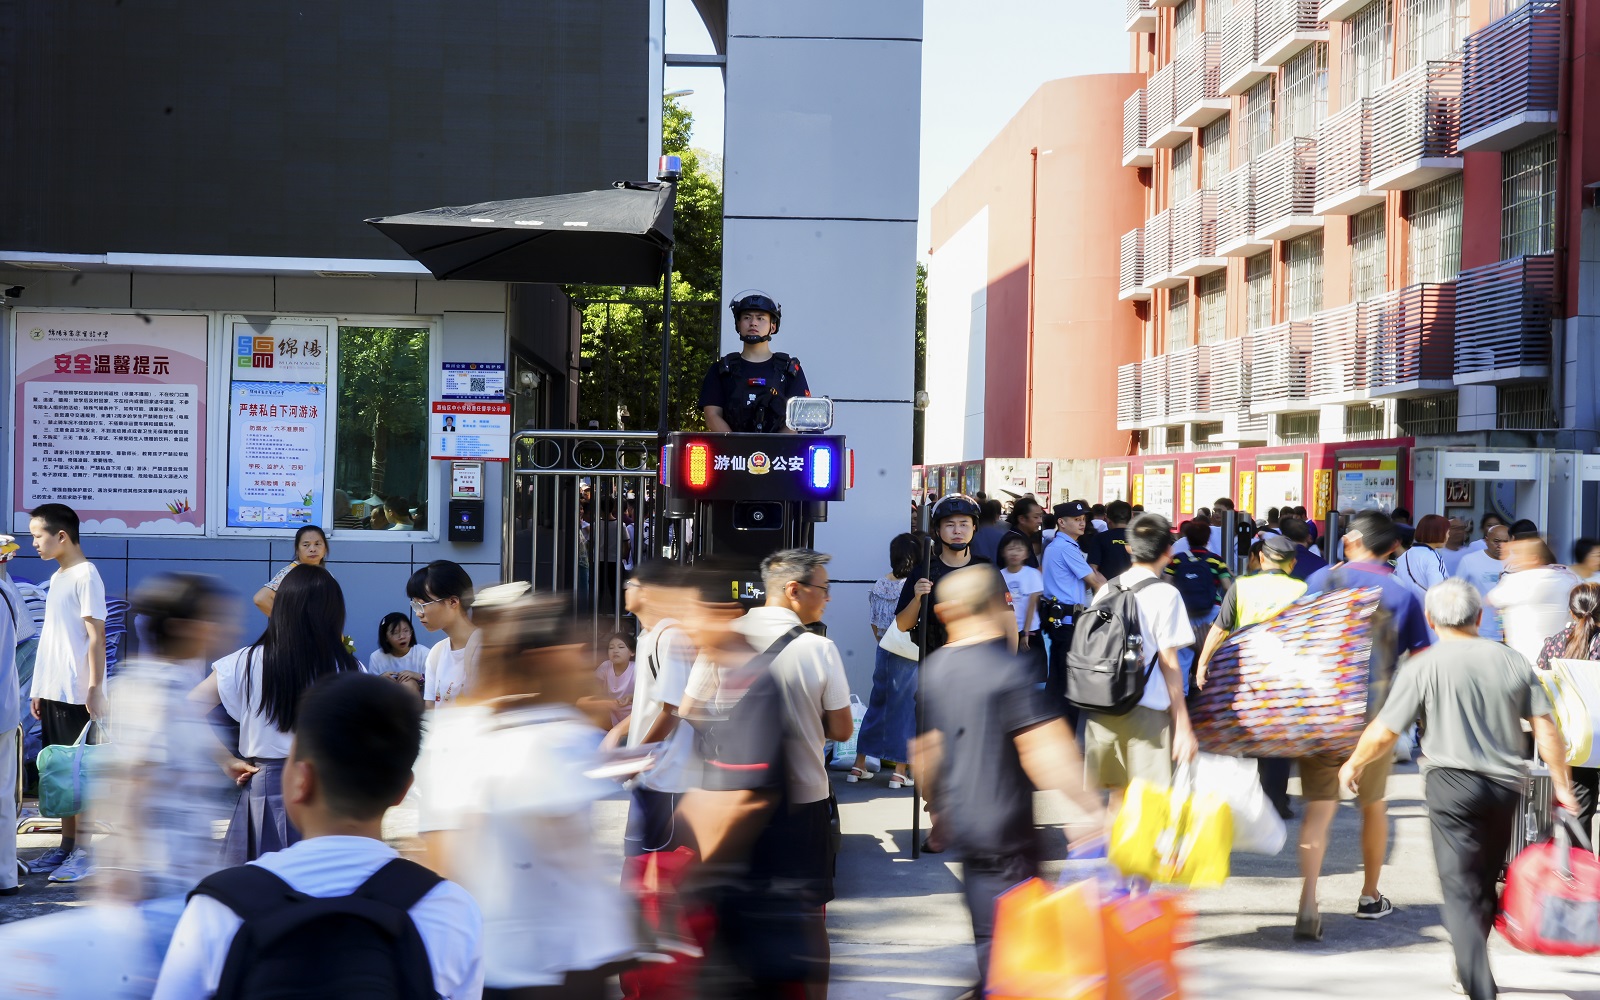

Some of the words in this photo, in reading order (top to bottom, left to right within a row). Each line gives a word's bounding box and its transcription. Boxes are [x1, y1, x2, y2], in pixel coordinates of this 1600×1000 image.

[54, 354, 170, 374] 安全温馨提示
[239, 403, 318, 418] 严禁私自下河游泳
[714, 454, 746, 471] 游仙
[771, 455, 805, 472] 公安
